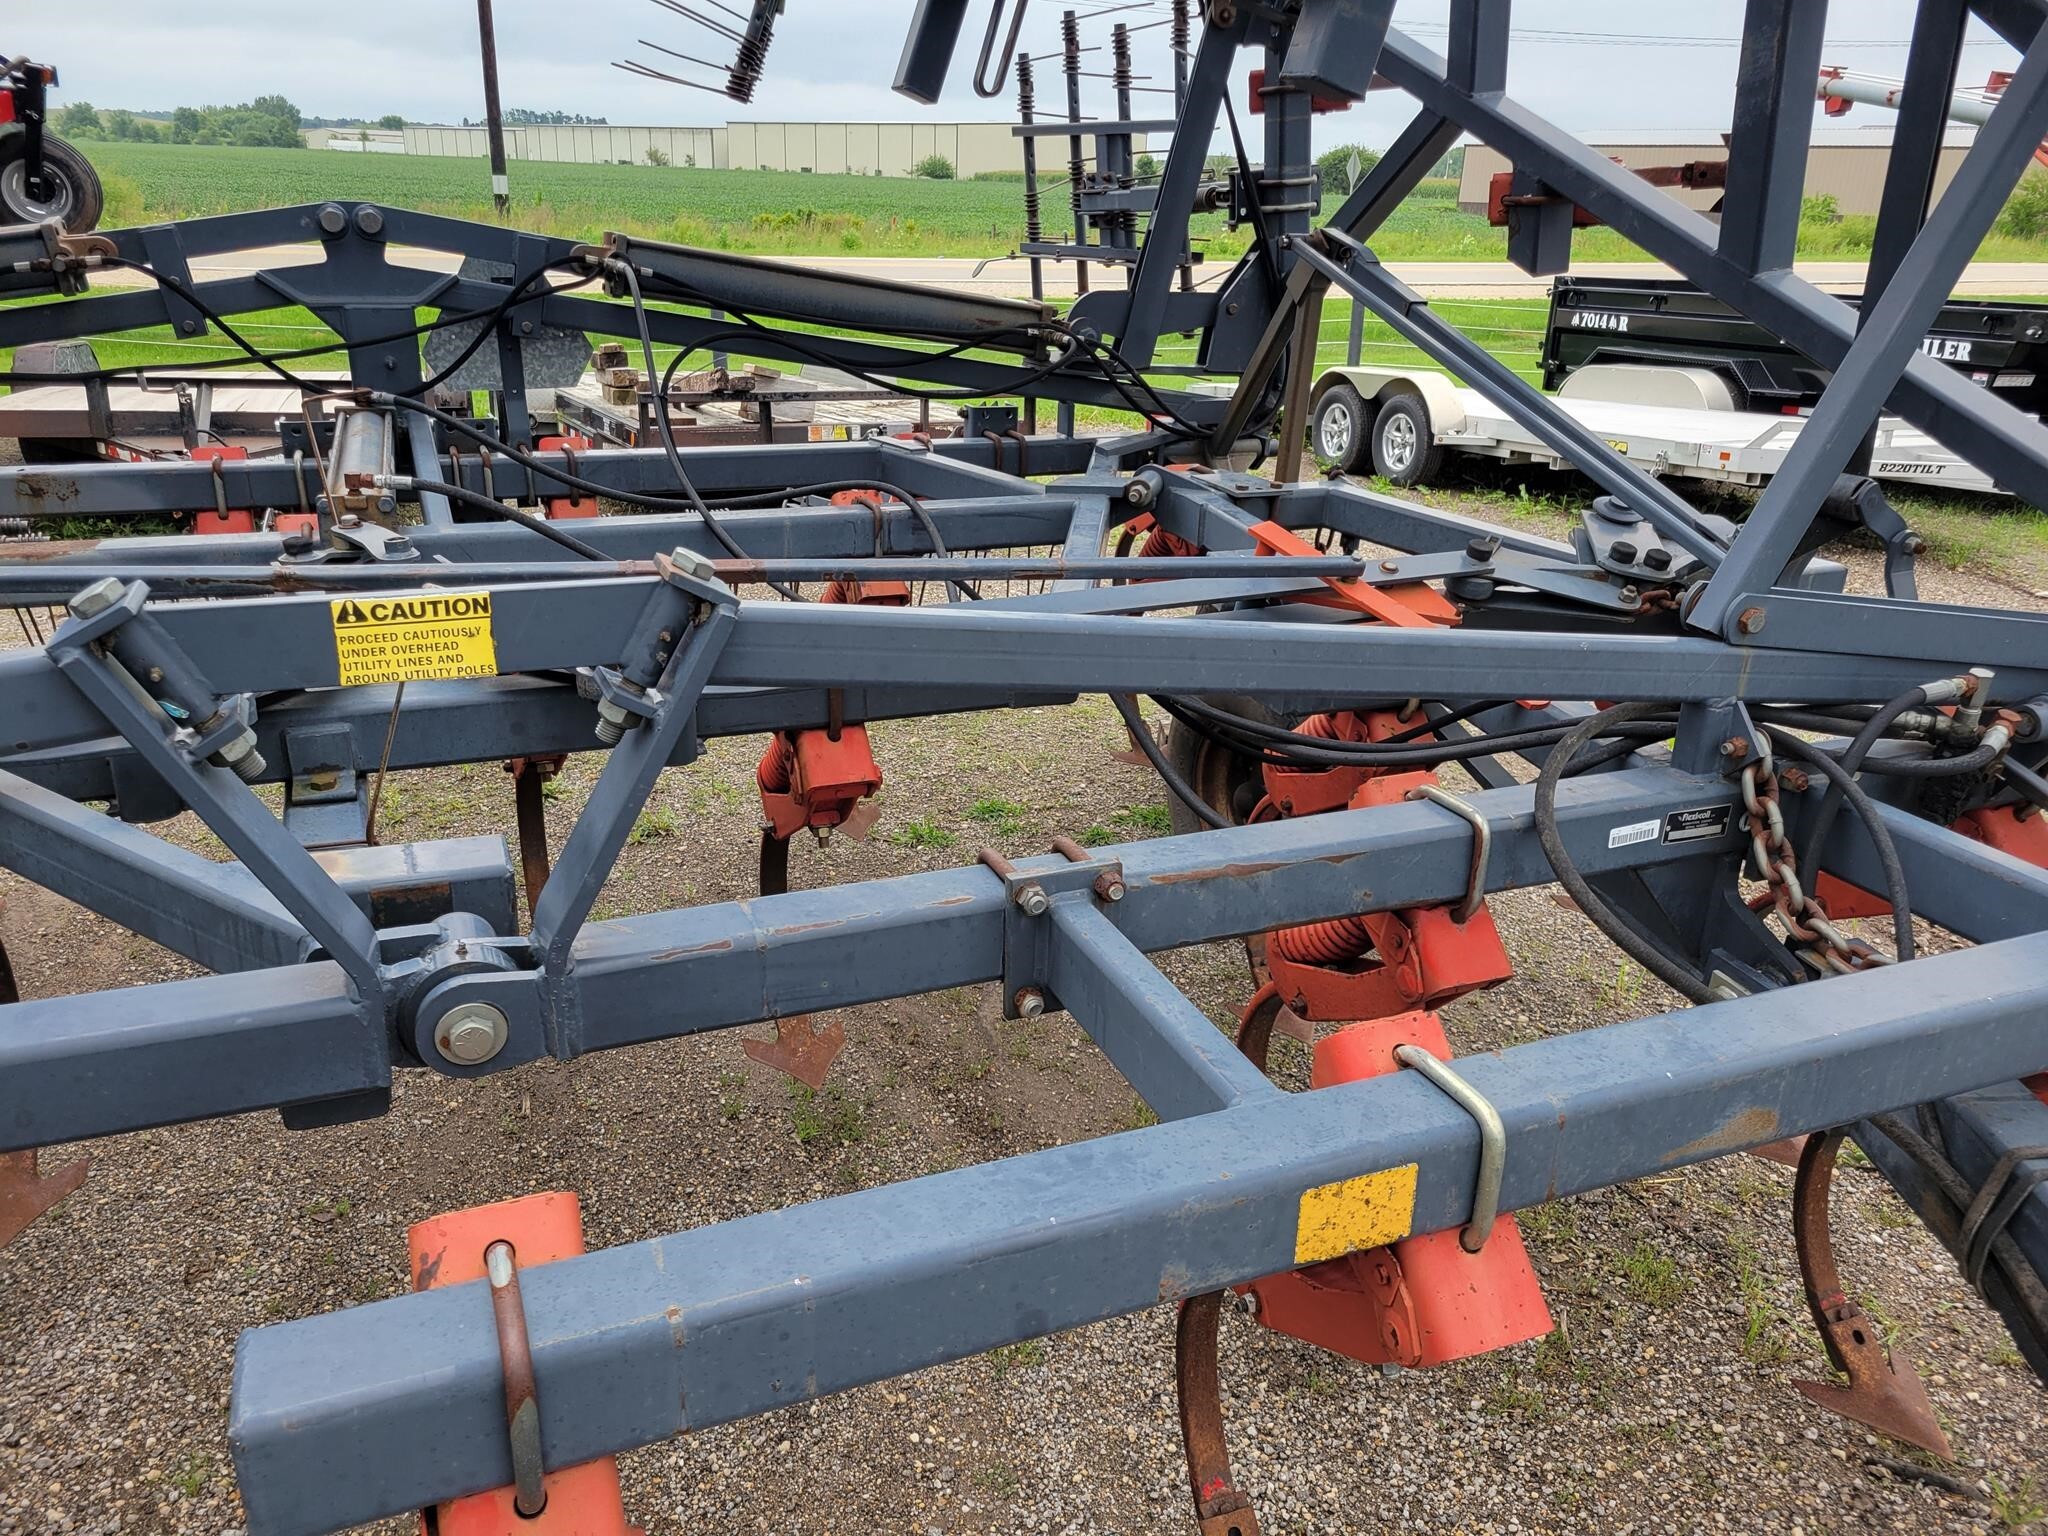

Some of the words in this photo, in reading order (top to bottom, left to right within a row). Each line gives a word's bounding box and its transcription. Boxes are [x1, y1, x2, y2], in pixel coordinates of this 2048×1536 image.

[1580, 312, 1608, 329] 7014
[1618, 316, 1628, 331] R
[1922, 338, 1971, 361] ILER
[1878, 463, 1947, 474] 8220TILT
[370, 597, 490, 622] CAUTION
[339, 632, 399, 646] PROCEED
[403, 626, 482, 641] CAUTIOUSLY
[341, 646, 387, 660] UNDER
[391, 641, 460, 655] OVERHEAD
[343, 659, 392, 672] UTILITY
[396, 656, 433, 668] LINES
[437, 653, 464, 665] AND
[345, 672, 400, 685] AROUND
[404, 668, 452, 681] UTILITY
[457, 664, 495, 676] POLES
